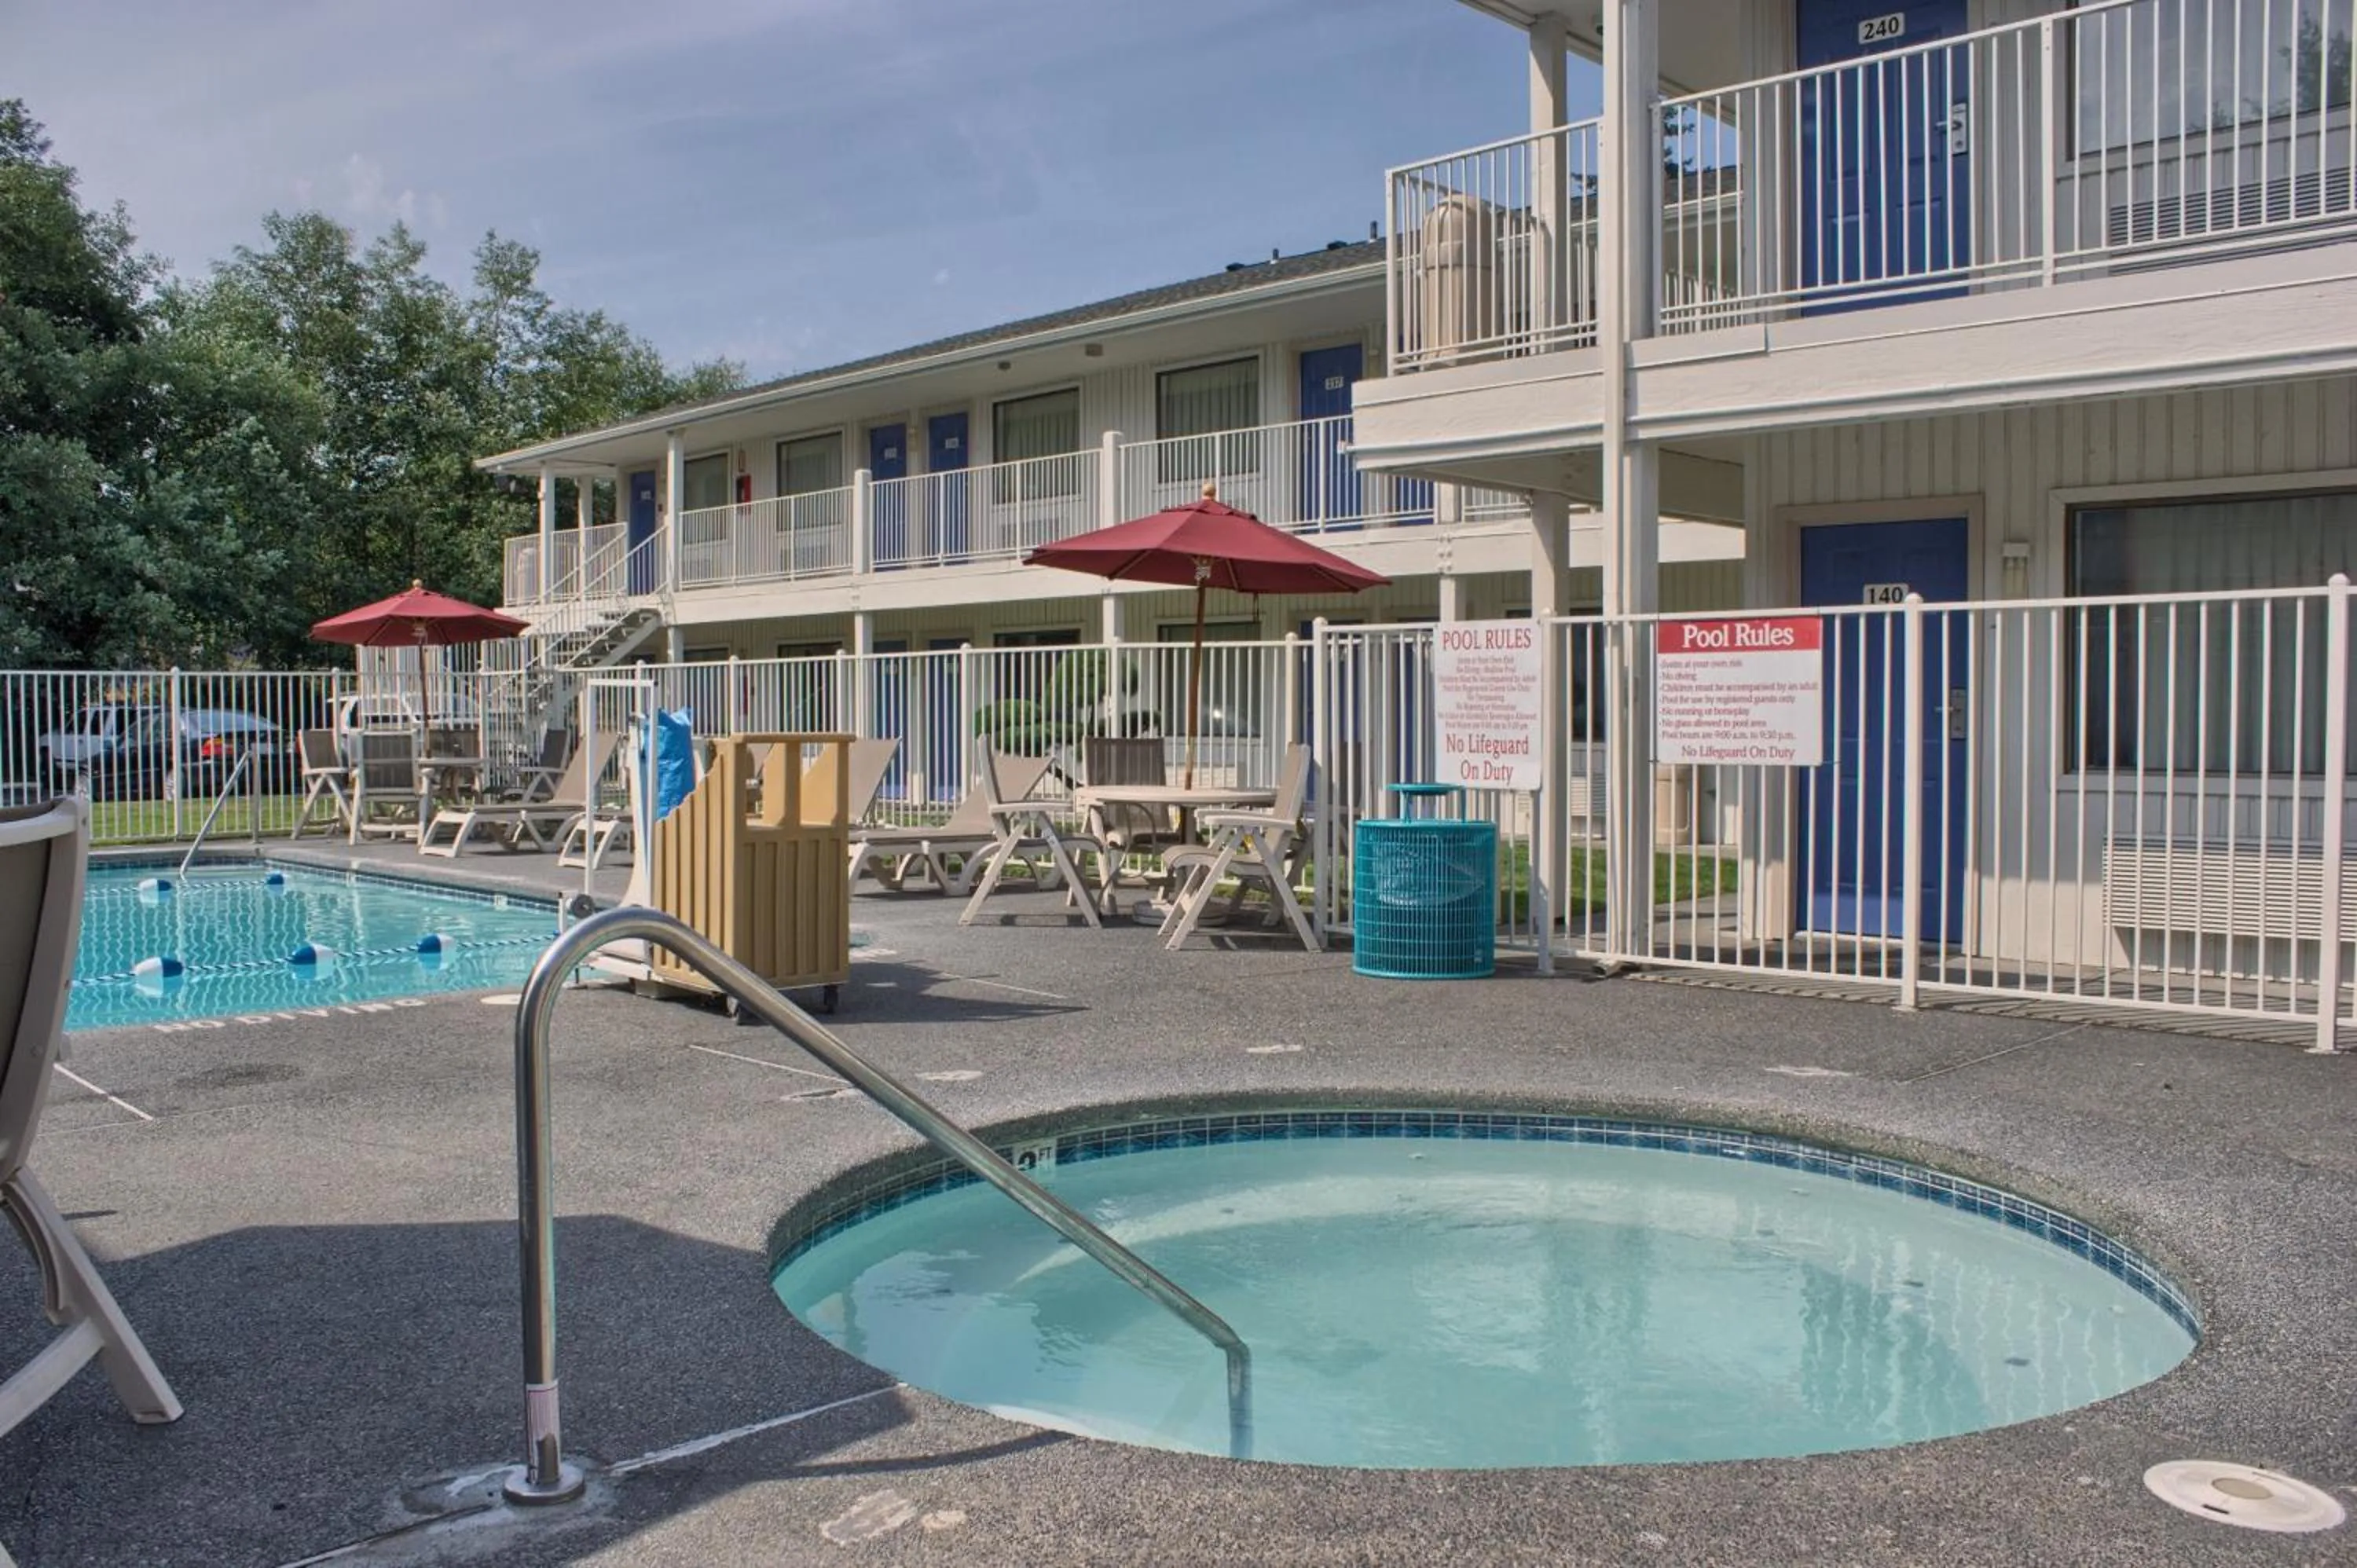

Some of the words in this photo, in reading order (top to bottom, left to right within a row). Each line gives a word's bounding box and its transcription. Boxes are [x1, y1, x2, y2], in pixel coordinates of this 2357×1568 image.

[1864, 16, 1900, 39] 240
[1869, 587, 1903, 603] 140
[1442, 629, 1482, 651] POOL
[1486, 628, 1531, 650] RULES
[1681, 624, 1729, 648] Pool
[1734, 622, 1794, 647] Rules
[1446, 733, 1464, 753] No
[1468, 733, 1529, 759] Lifeguard
[1681, 746, 1697, 757] No
[1699, 746, 1747, 759] Lifeguard
[1750, 746, 1766, 758] On
[1769, 746, 1796, 760] Duty
[1461, 760, 1479, 780] On
[1483, 760, 1513, 785] Duty
